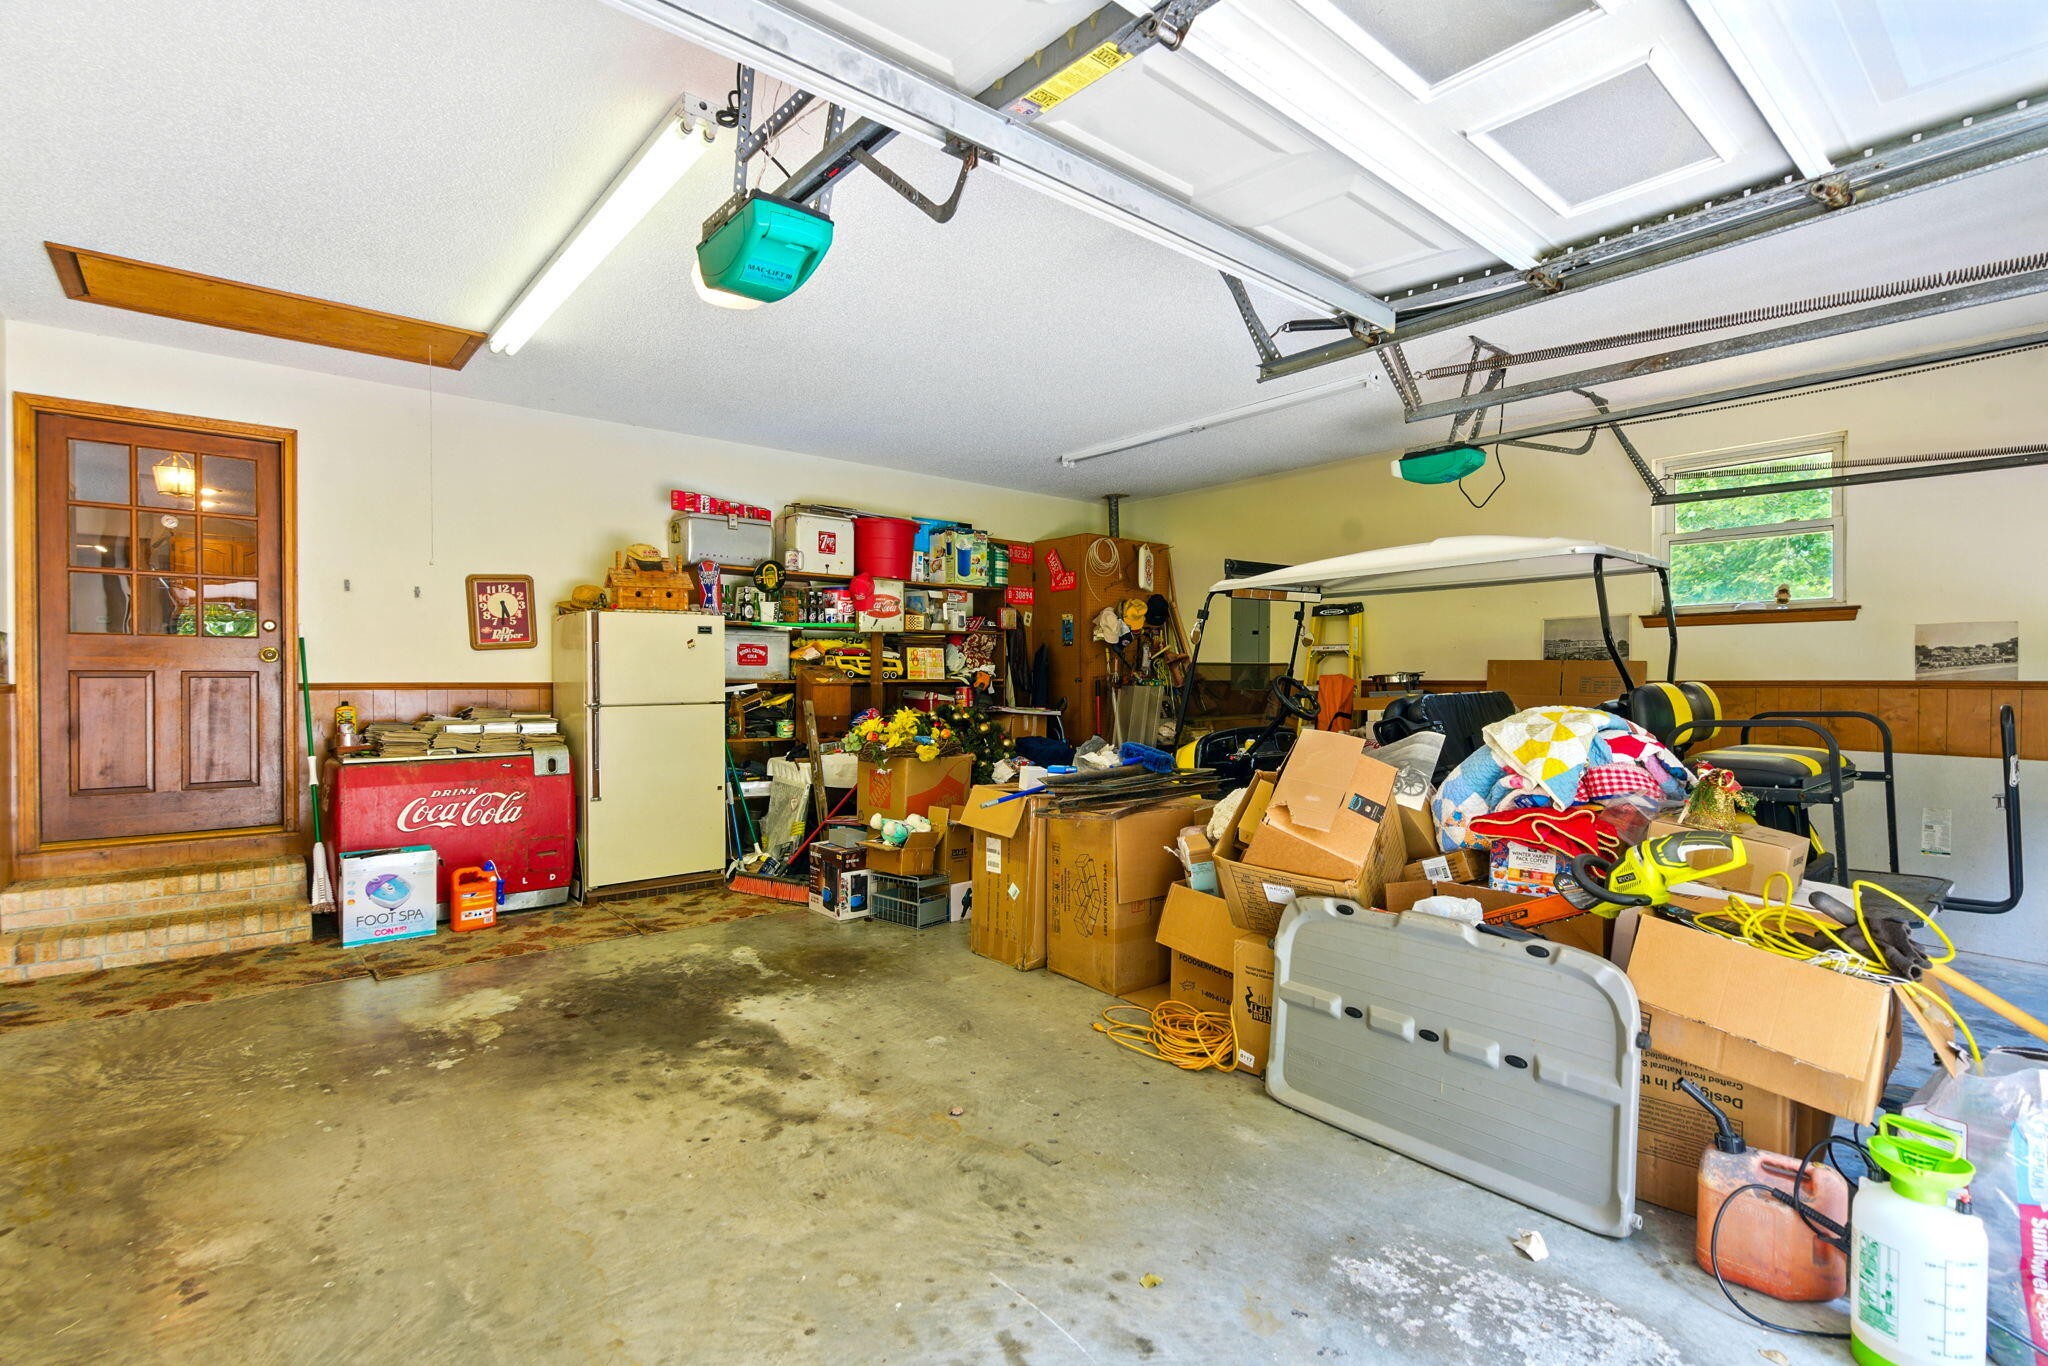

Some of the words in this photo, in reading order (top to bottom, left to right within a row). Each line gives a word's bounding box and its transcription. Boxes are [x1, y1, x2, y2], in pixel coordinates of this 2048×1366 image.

[486, 585, 496, 594] 11
[497, 584, 510, 593] 12
[511, 586, 515, 594] 1
[479, 594, 491, 603] 10
[516, 592, 524, 600] 2
[479, 602, 488, 611] 9
[518, 601, 525, 610] 3
[482, 611, 491, 620] 8
[515, 609, 522, 618] 4
[491, 617, 499, 626] 7
[509, 617, 517, 625] 5
[430, 787, 479, 798] DRINK
[396, 791, 527, 833] Coca-Cola
[1512, 850, 1532, 858] WINTER
[1532, 852, 1554, 861] VARIETY
[549, 873, 556, 881] D
[356, 911, 396, 928] FOOT
[398, 908, 424, 922] SPA
[1487, 910, 1526, 926] WEEP
[1650, 1061, 1682, 1076] Natural
[1684, 1070, 1706, 1081] from
[1655, 1077, 1668, 1090] in
[1708, 1076, 1744, 1091] Crafted
[1672, 1083, 1744, 1110] Desigd
